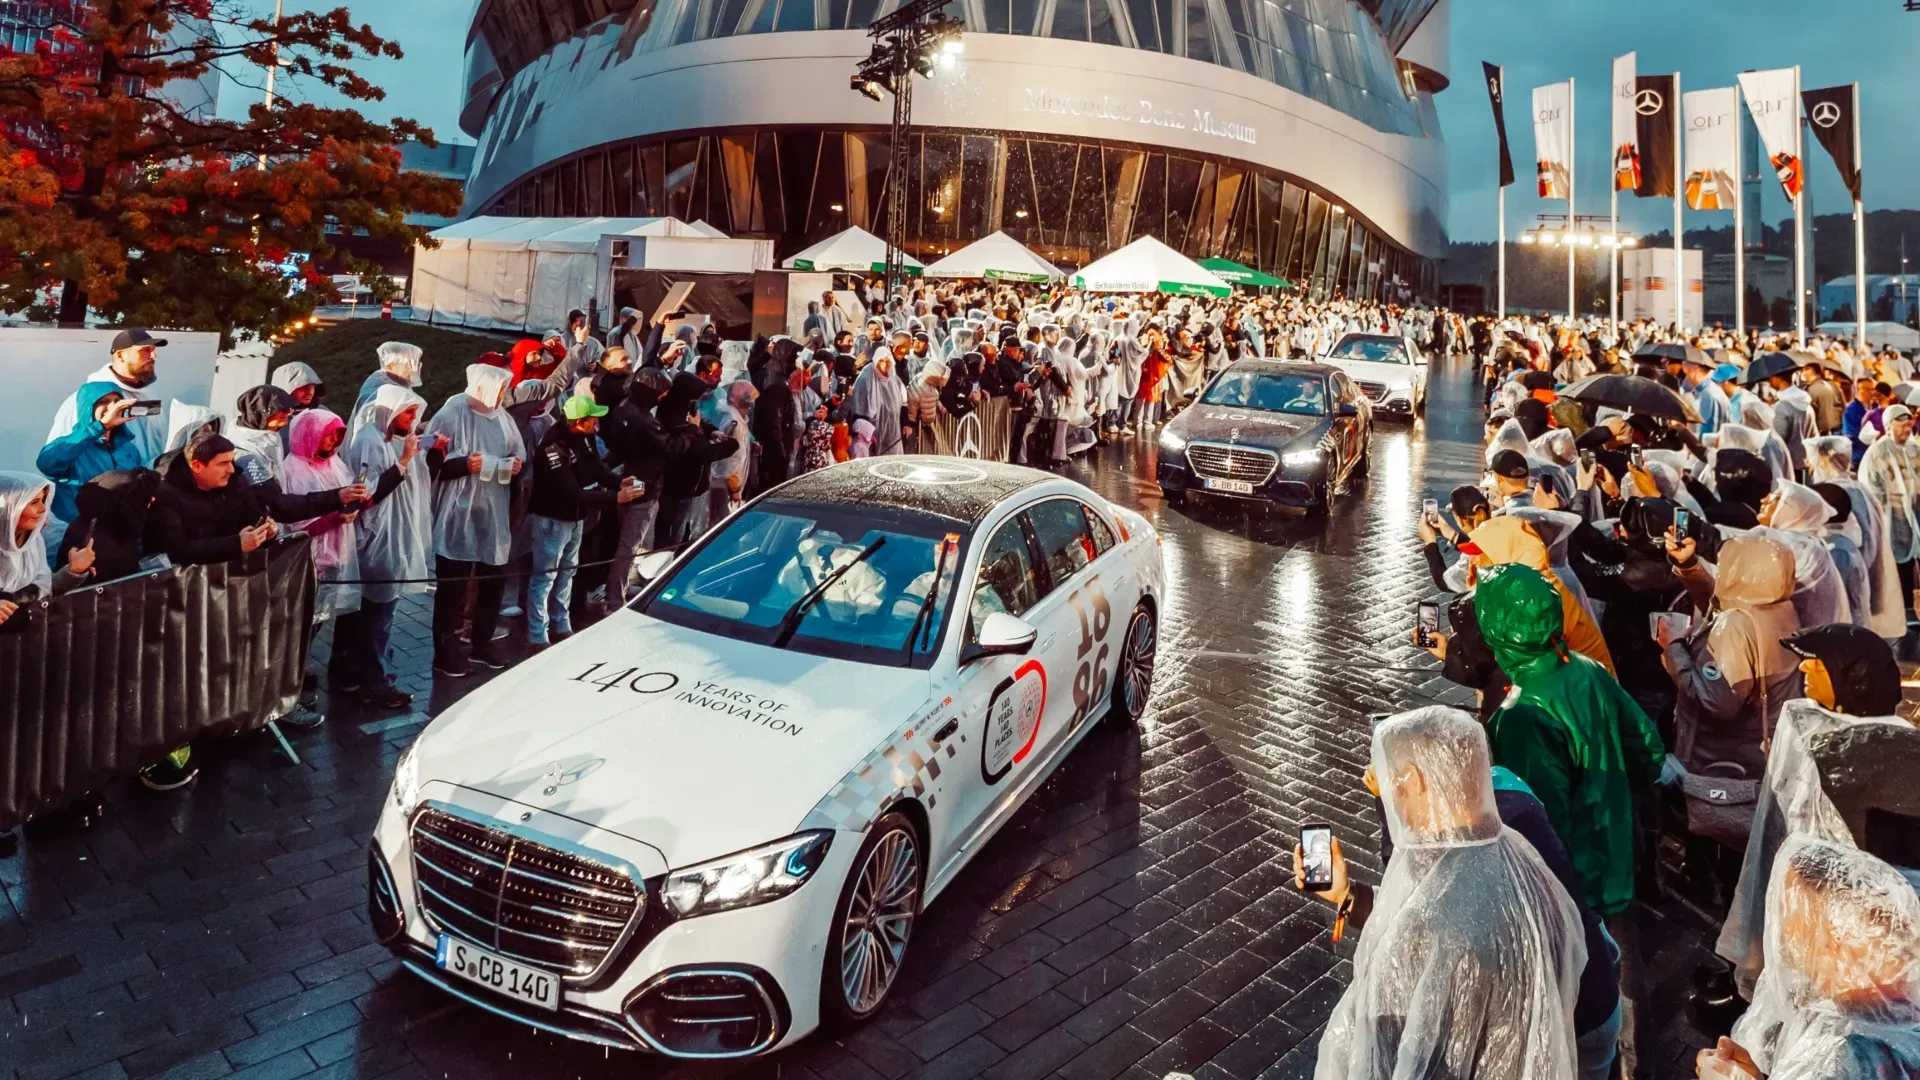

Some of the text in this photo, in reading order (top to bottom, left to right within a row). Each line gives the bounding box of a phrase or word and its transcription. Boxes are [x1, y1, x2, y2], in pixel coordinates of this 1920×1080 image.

[1025, 88, 1257, 144] Mercedes Benz Museum
[1211, 479, 1249, 492] S BB 140
[567, 661, 680, 693] 140
[693, 680, 789, 713] YEARS OF
[675, 691, 804, 737] INNOVATION
[454, 946, 549, 1002] S CB 140
